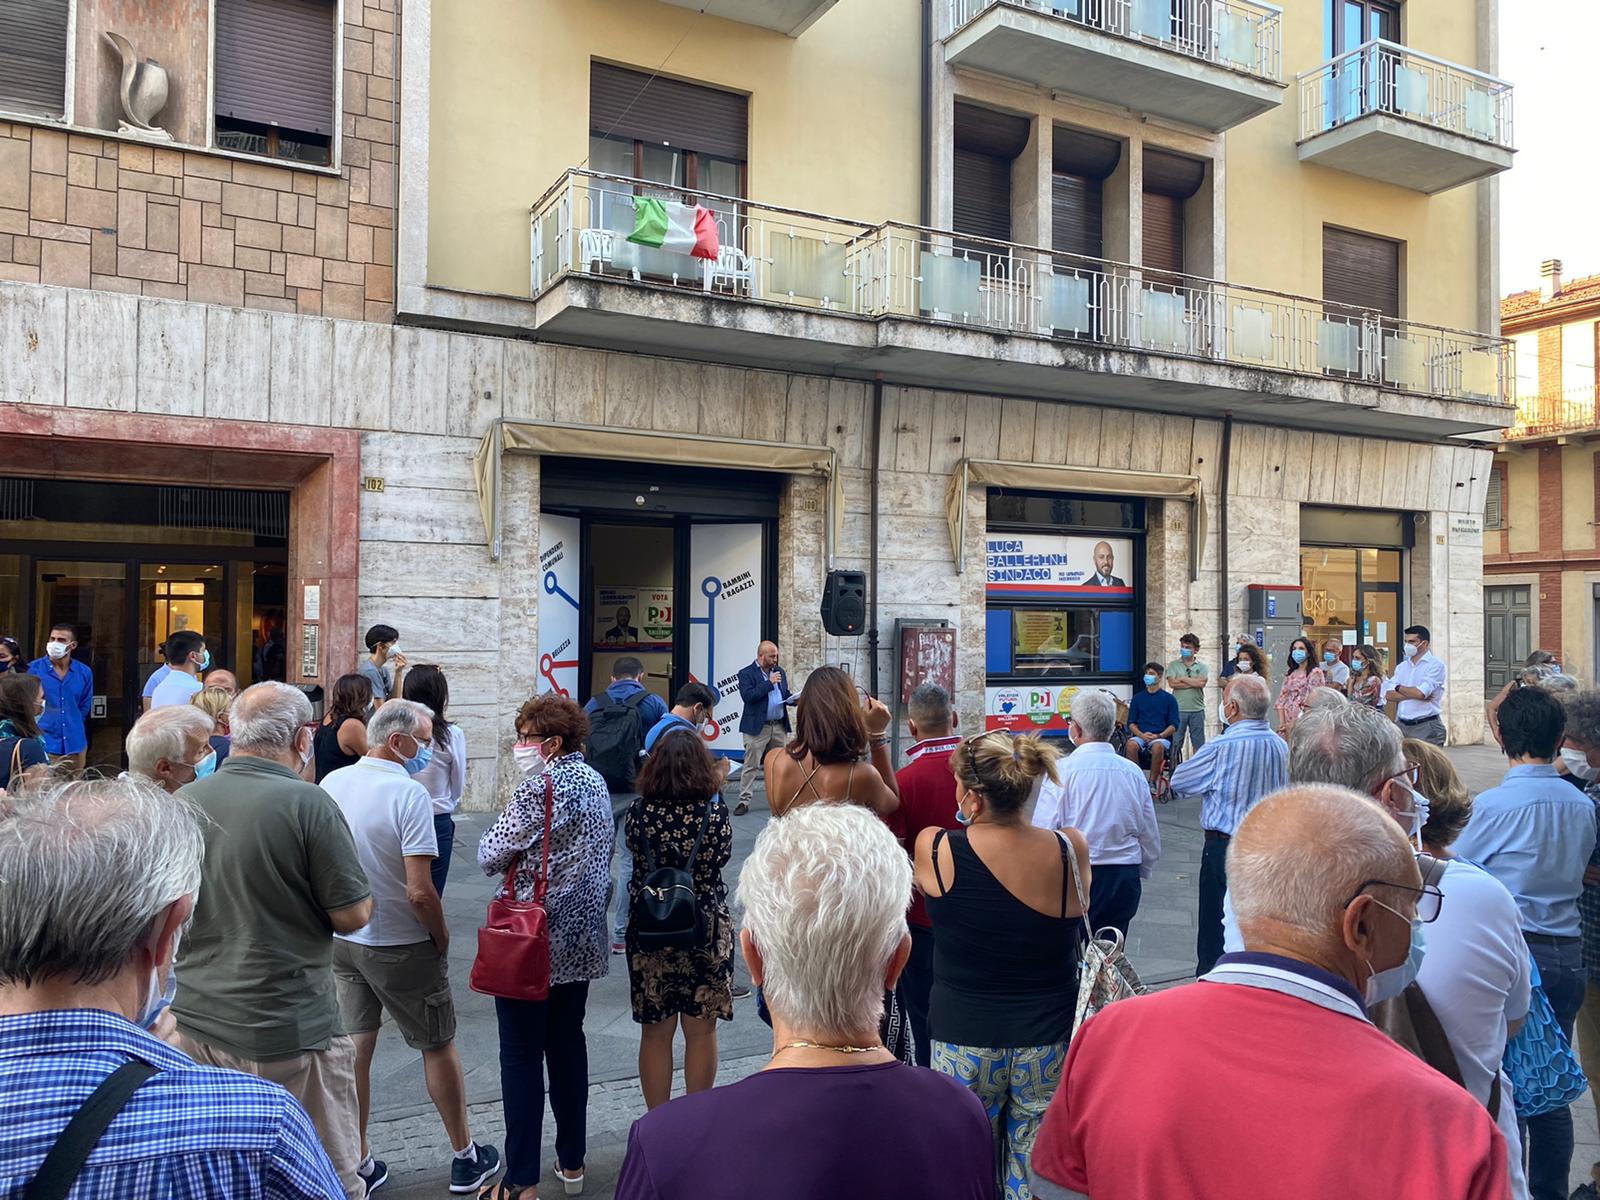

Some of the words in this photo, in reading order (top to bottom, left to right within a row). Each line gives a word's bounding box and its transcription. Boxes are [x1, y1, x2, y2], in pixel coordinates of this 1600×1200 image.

[367, 479, 382, 490] 102
[540, 541, 563, 563] DIPENDENTI
[986, 541, 1023, 552] LUCA
[542, 552, 564, 572] COMUNALI
[987, 554, 1067, 567] BALLERINI
[722, 571, 752, 589] BAMBINI
[988, 568, 1050, 581] SINDACO
[726, 579, 755, 598] RAGAZZI
[651, 593, 669, 601] VOTA
[552, 638, 571, 659] BELLEZZA
[1030, 692, 1051, 707] PD
[717, 711, 740, 726] UNDER
[721, 726, 732, 735] 30
